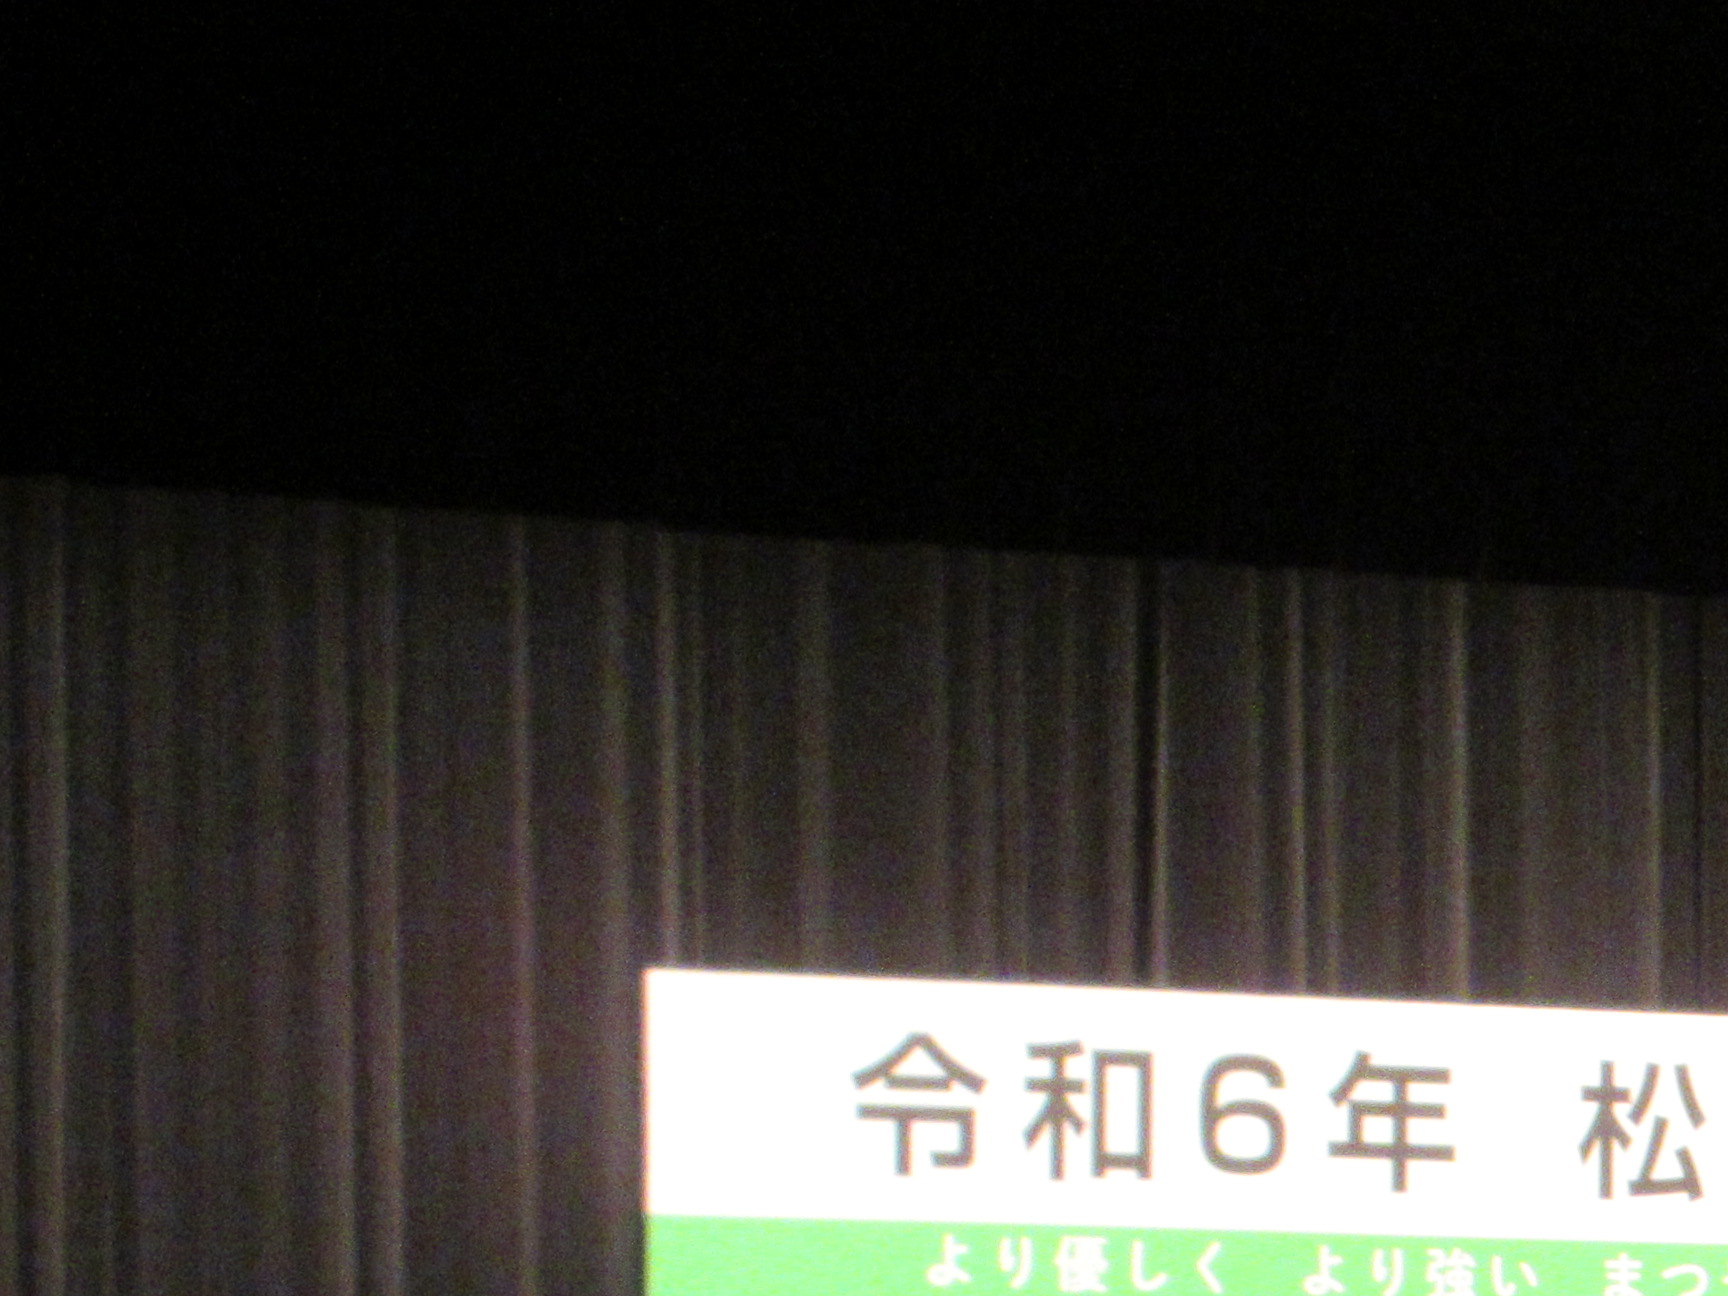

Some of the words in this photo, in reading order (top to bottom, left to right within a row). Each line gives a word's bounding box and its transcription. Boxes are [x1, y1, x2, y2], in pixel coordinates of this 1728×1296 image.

[851, 1033, 1457, 1193] 令和6年
[923, 1234, 1226, 1296] より優しく
